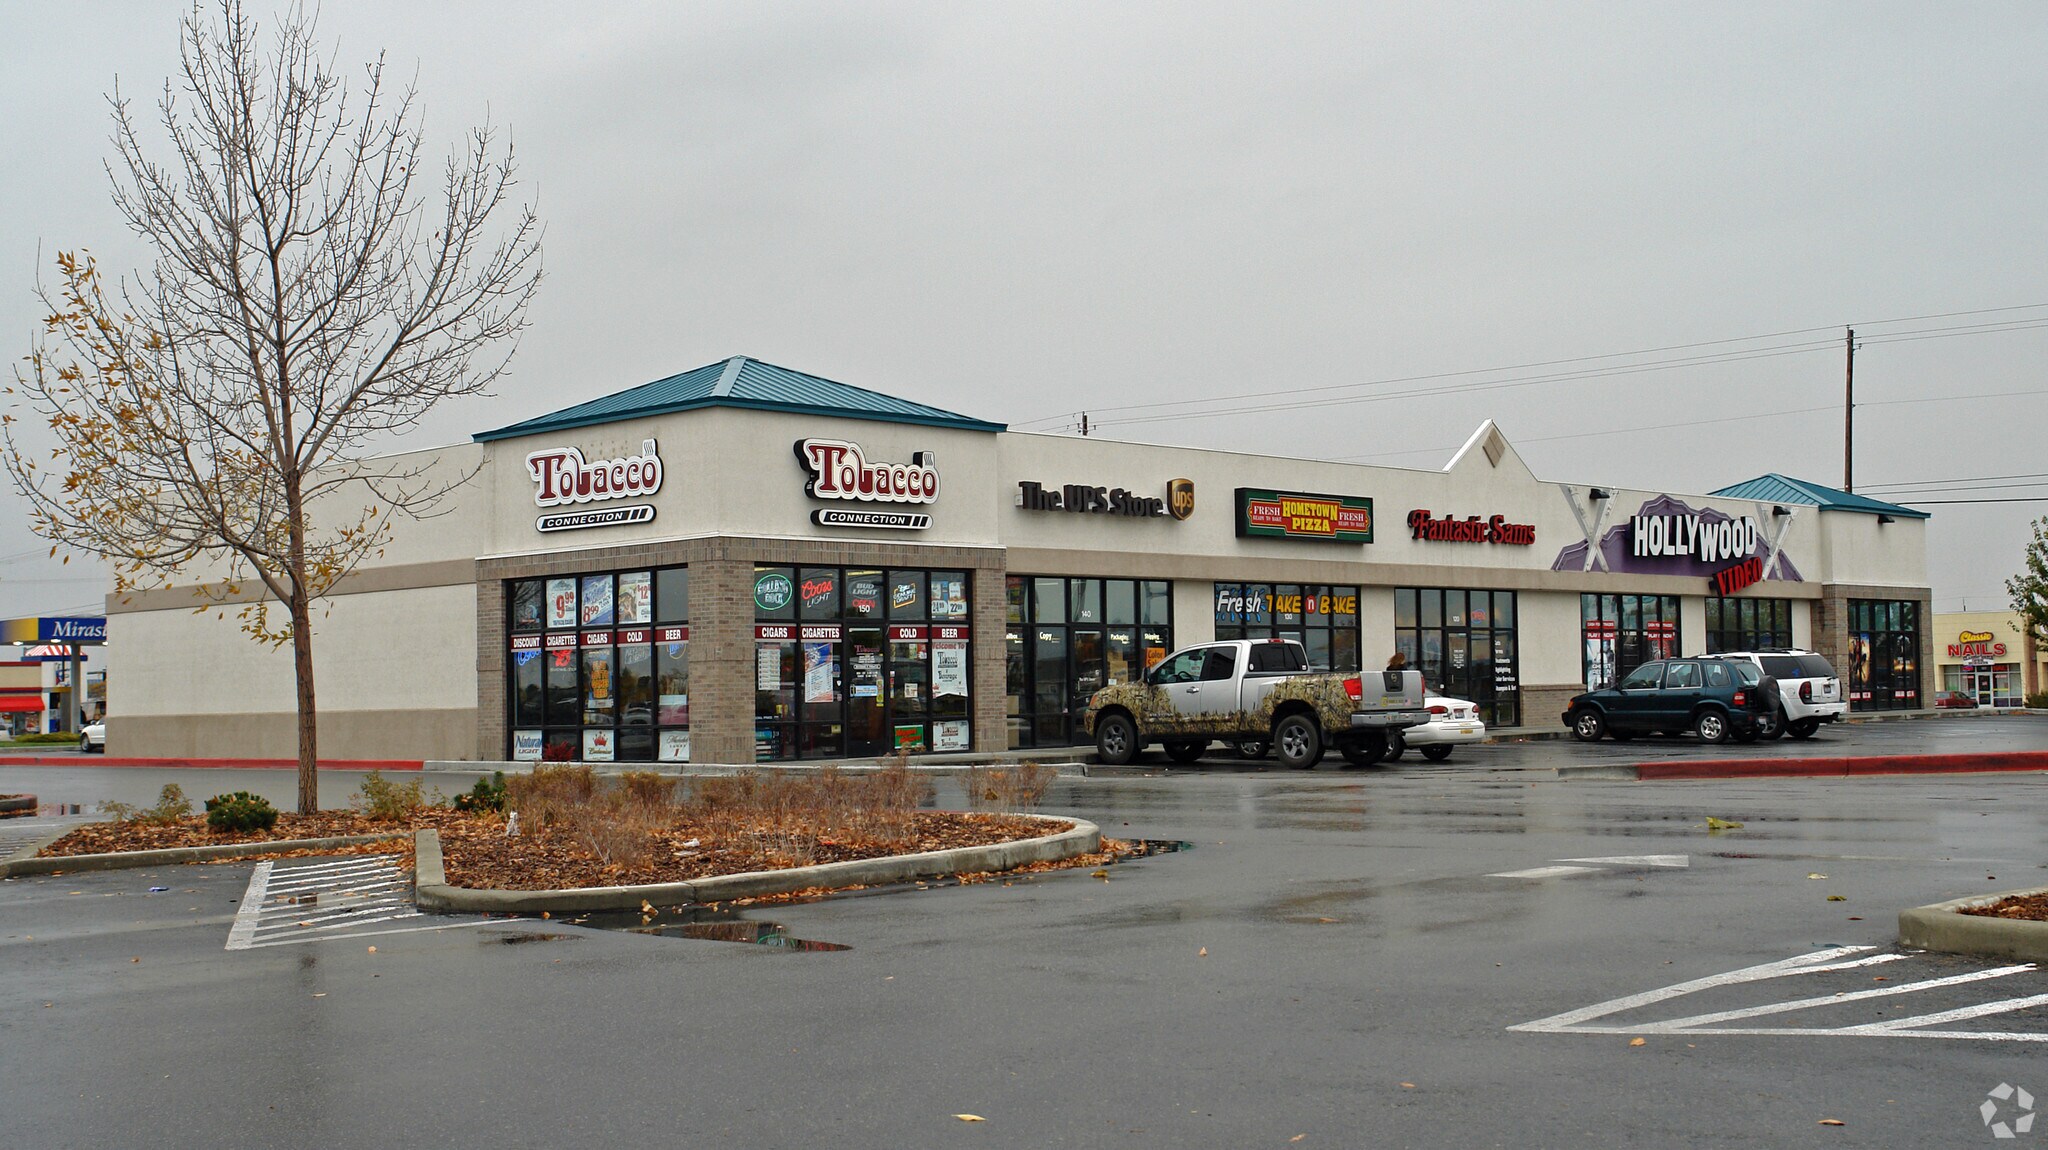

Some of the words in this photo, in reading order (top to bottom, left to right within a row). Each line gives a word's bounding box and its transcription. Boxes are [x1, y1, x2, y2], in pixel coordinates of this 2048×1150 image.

[529, 446, 660, 502] Tobacco
[808, 443, 938, 500] Tobacco
[1019, 481, 1062, 511] The
[1063, 484, 1109, 514] UPS
[1109, 488, 1164, 517] Store
[1173, 489, 1193, 514] ups
[1253, 506, 1281, 517] FRESH
[1282, 500, 1338, 521] HOMETOWN
[546, 511, 625, 528] CONNECTION
[829, 511, 907, 525] CONNECTION
[1339, 512, 1364, 522] FRESH
[1292, 518, 1331, 532] PIZZA
[1407, 509, 1489, 543] Fantastic
[1489, 514, 1536, 545] Sams
[1633, 514, 1758, 562] HOLLYWOOD
[1717, 557, 1763, 596] VIDEO
[801, 580, 833, 600] Coors
[852, 588, 878, 596] LIGHT
[807, 592, 831, 608] LIGHT
[1217, 590, 1262, 613] Fresh
[1265, 594, 1302, 613] TAKE
[1319, 595, 1357, 614] BAKE
[858, 605, 870, 613] 150
[1081, 610, 1092, 618] 140
[587, 633, 608, 644] CIGARS
[627, 631, 643, 642] COLD
[665, 629, 682, 640] BEER
[761, 627, 788, 638] CIGARS
[802, 627, 840, 638] CIGARETTES
[900, 628, 917, 638] COLD
[941, 628, 958, 638] BEER
[1039, 631, 1053, 641] Copy
[1960, 631, 1993, 643] Classic
[513, 637, 540, 648] DISCOUNT
[546, 634, 577, 646] CIGARETTES
[957, 642, 965, 650] To
[1148, 651, 1163, 659] Color
[1947, 643, 2006, 656] NAILS
[516, 735, 542, 748] Natural
